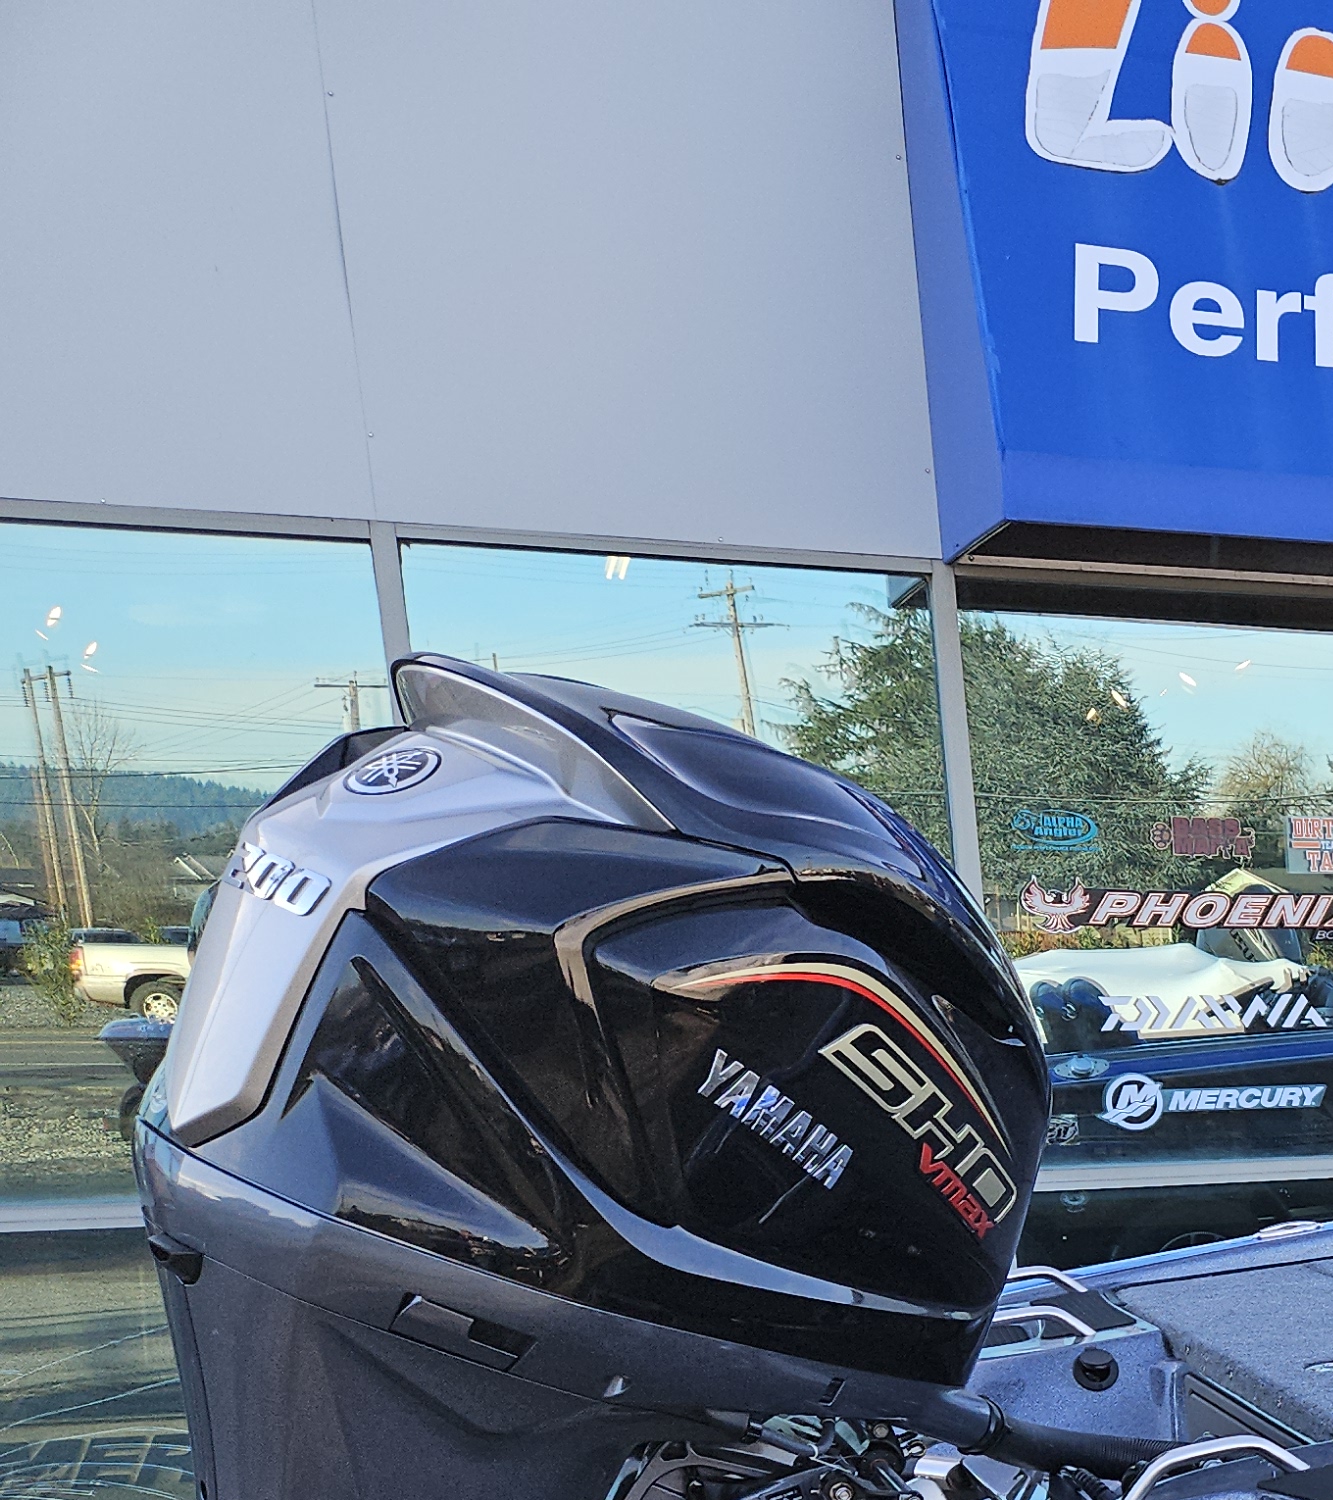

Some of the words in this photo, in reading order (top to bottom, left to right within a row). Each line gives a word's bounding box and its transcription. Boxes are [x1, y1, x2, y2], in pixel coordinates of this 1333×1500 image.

[1043, 815, 1083, 828] ALPHA
[1099, 993, 1329, 1032] DAIWA
[1168, 1086, 1317, 1112] MERCURY
[697, 1048, 854, 1190] YAMAHA
